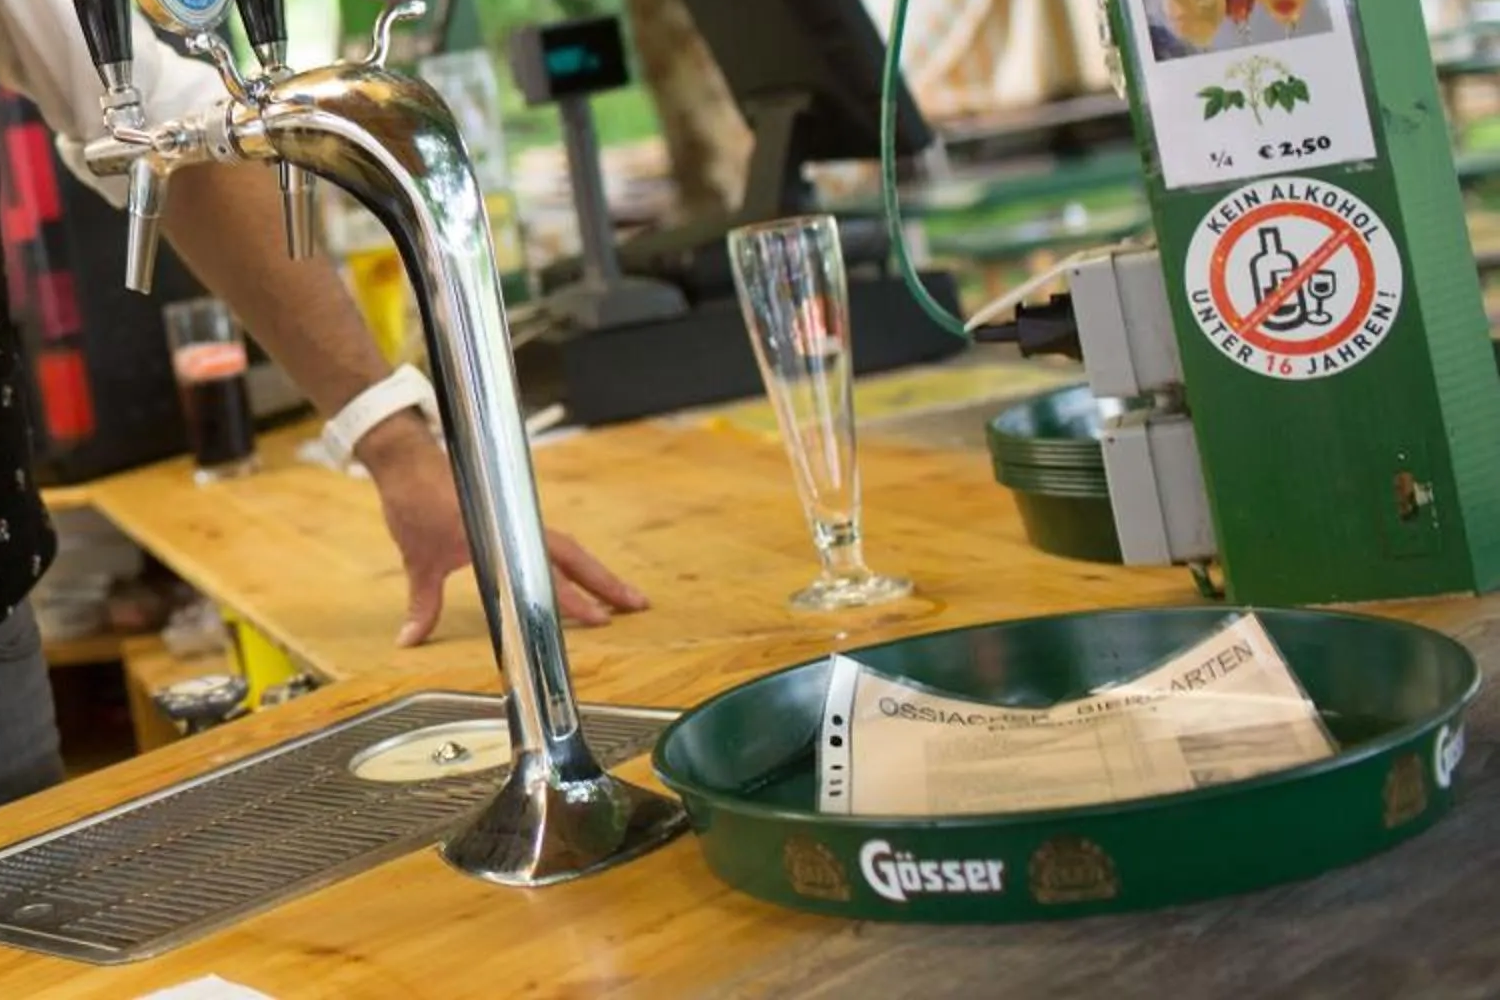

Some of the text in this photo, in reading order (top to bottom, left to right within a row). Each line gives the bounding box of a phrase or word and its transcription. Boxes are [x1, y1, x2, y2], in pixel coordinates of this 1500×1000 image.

[1278, 135, 1331, 158] 2,50
[1207, 183, 1380, 243] KEIN ALKOHOL
[1191, 289, 1397, 375] UNTER 16 JAHREN!
[859, 839, 1004, 901] Gösser
